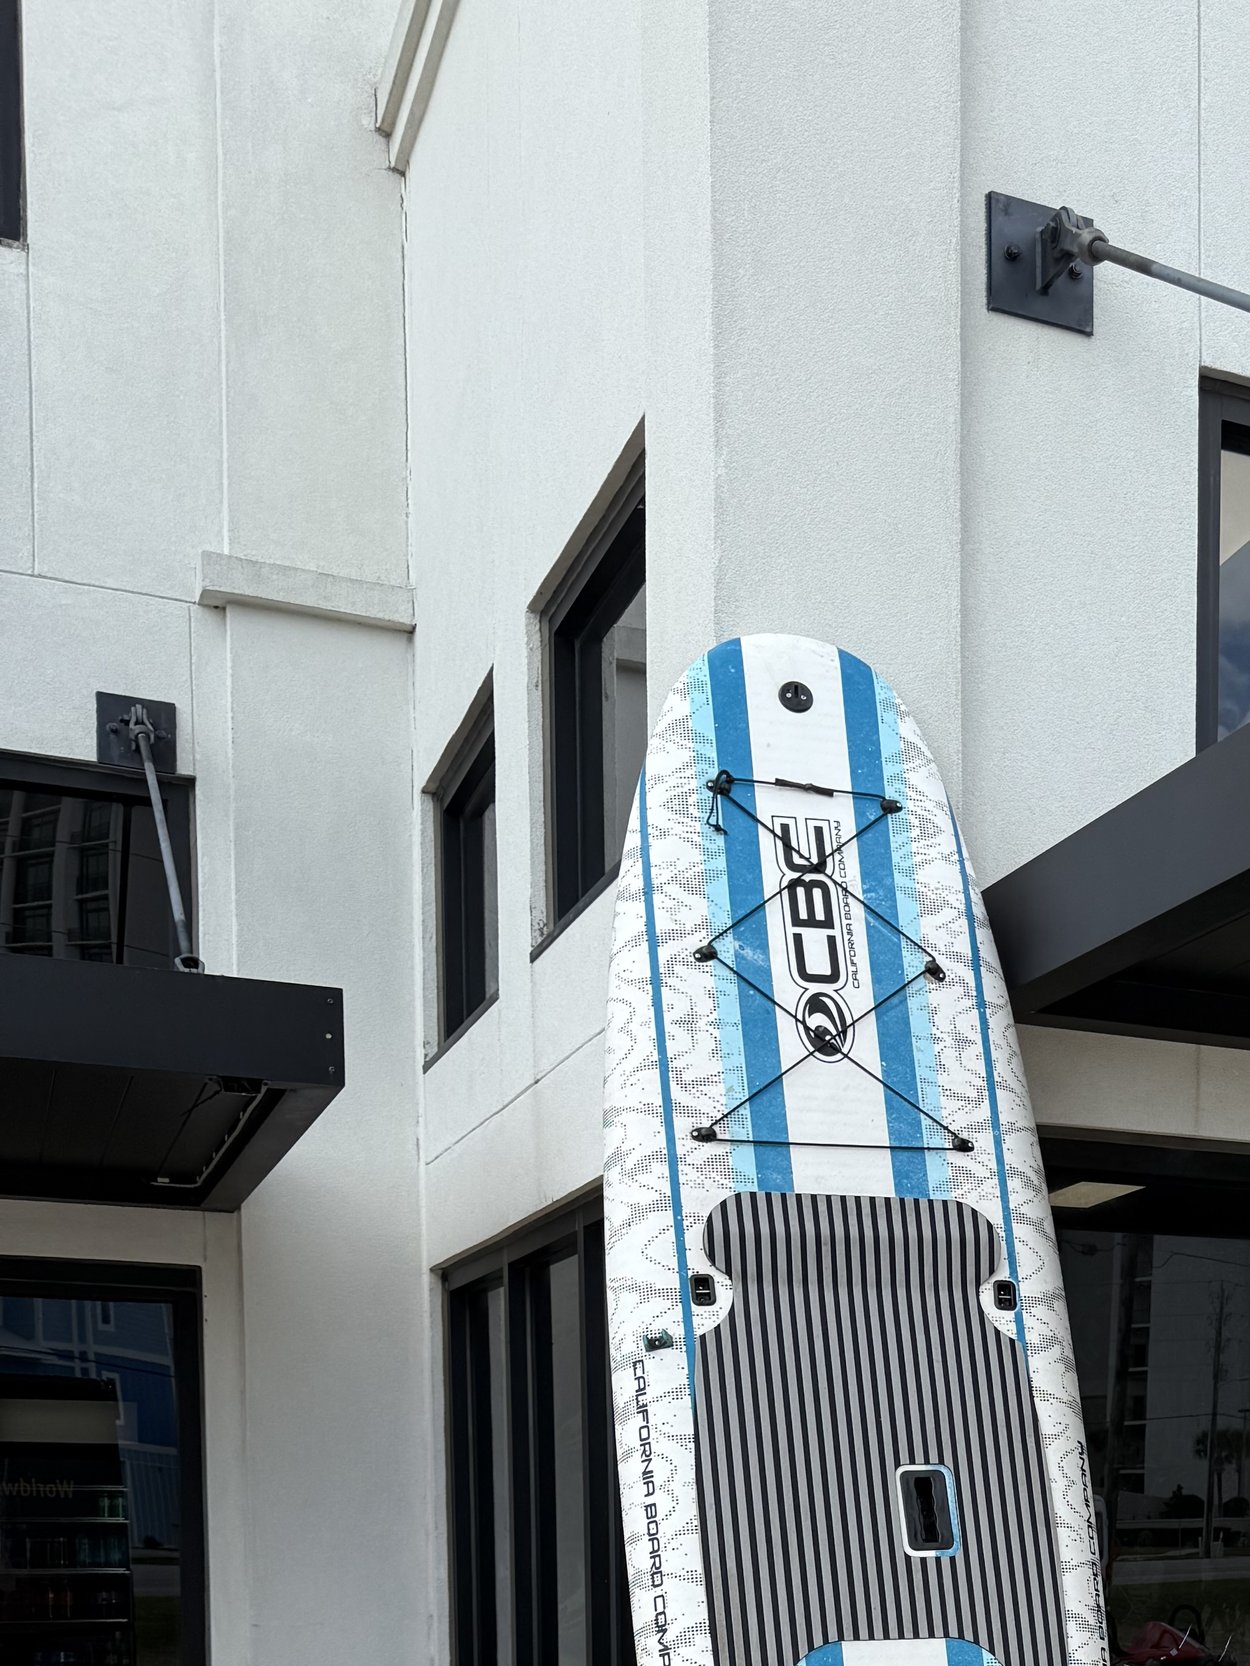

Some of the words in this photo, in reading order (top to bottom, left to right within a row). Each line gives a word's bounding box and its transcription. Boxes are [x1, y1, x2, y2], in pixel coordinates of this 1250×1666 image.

[833, 819, 847, 879] COMPANY
[840, 881, 852, 921] BOARD
[846, 923, 860, 989] CALIFORNIA
[632, 1359, 656, 1498] CALIFORNIA
[1077, 1439, 1097, 1556] COMPANY
[643, 1504, 664, 1588] BOARD
